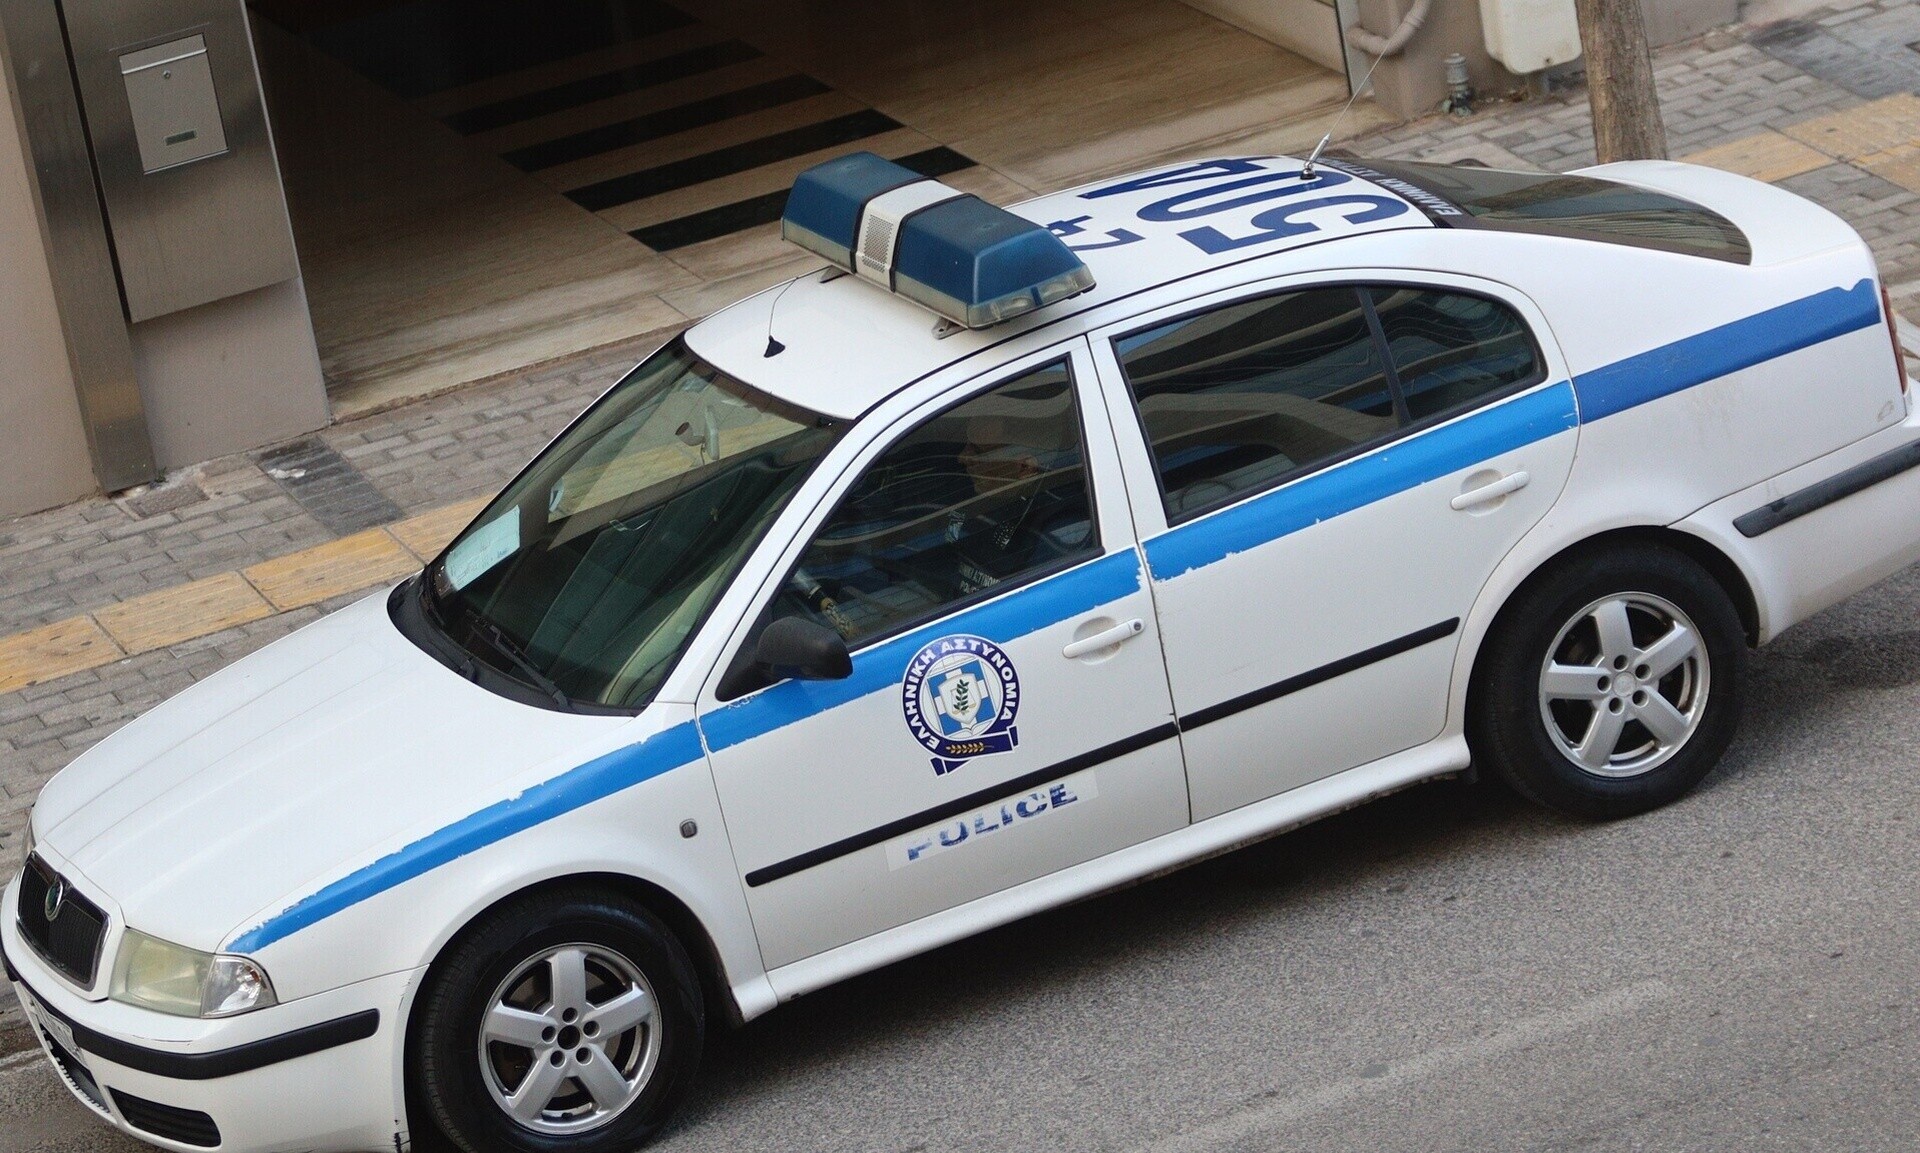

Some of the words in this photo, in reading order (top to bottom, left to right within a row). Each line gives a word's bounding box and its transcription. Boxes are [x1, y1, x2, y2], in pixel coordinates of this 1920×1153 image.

[1077, 157, 1409, 256] 504
[906, 648, 941, 750] ΕΛΛΗΝΙΚΗ
[939, 638, 1017, 722] ΑΣΤΥΝΟΜΙΑ
